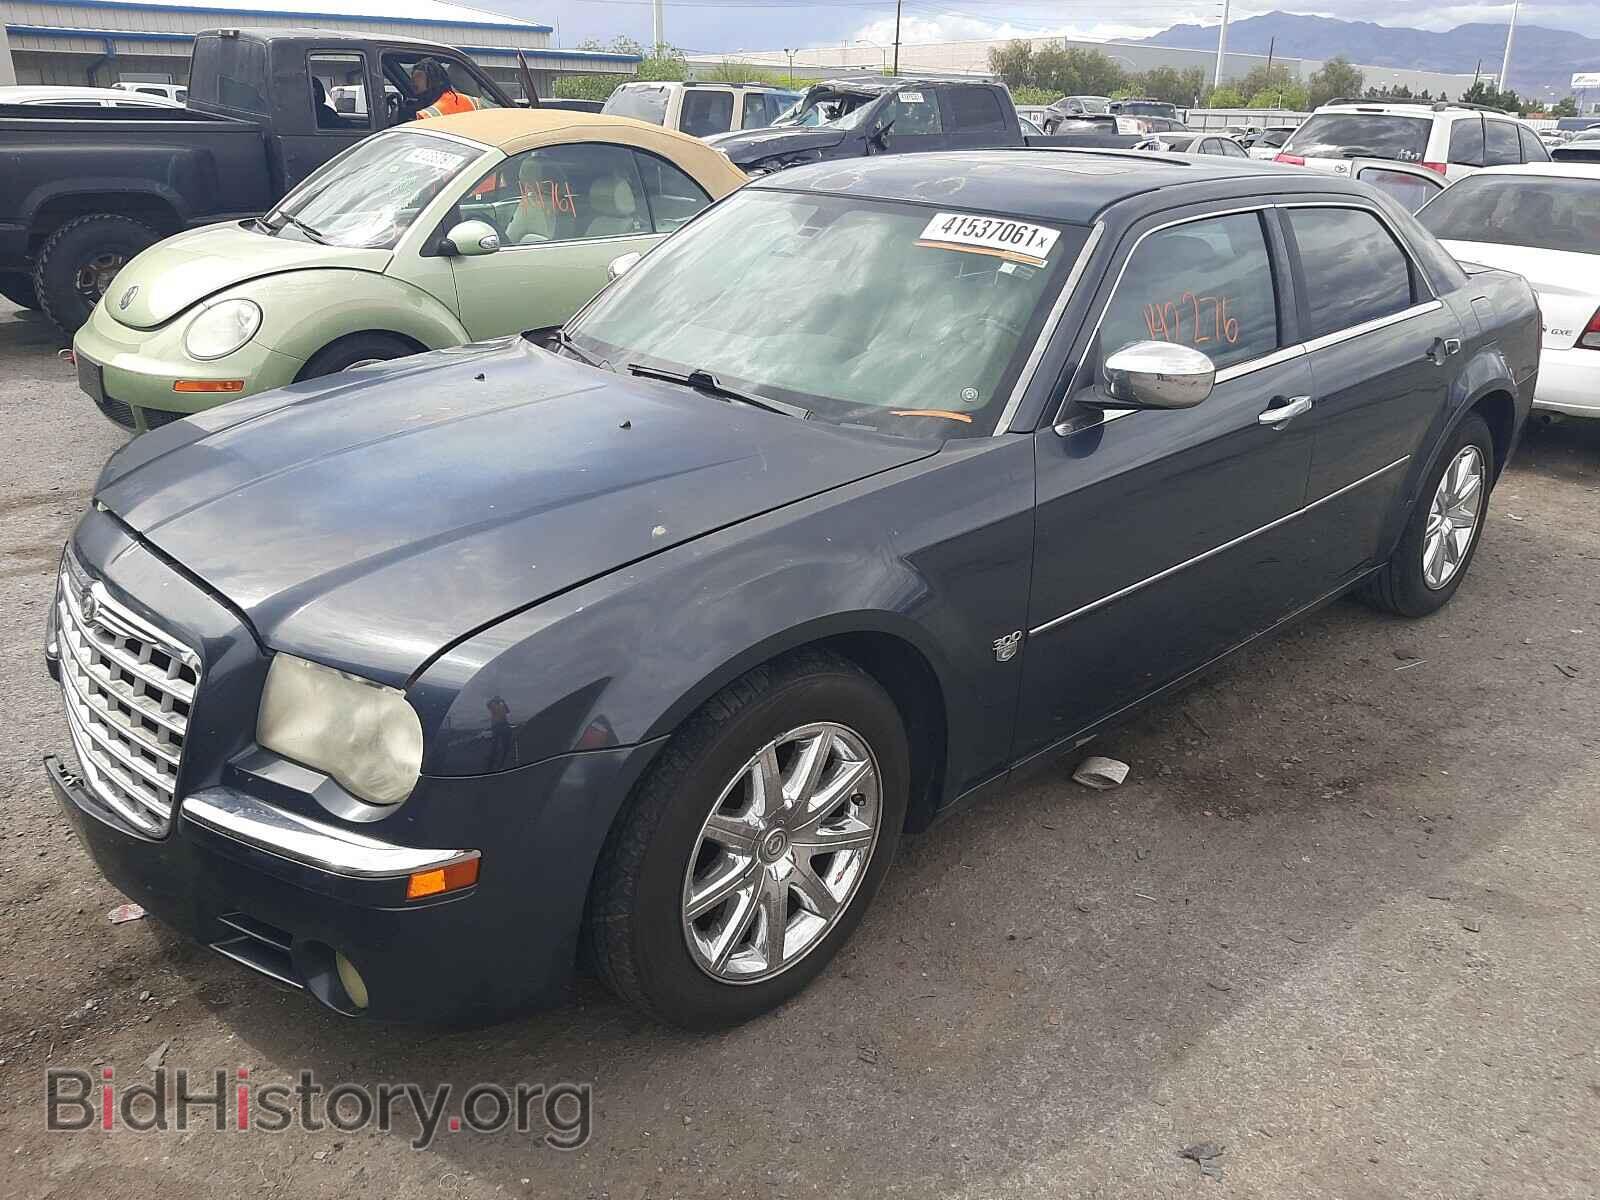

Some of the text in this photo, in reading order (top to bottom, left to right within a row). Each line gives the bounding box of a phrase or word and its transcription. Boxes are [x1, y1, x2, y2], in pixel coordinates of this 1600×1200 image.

[941, 216, 1039, 247] 41537061
[1551, 328, 1572, 336] GXE
[992, 630, 1023, 650] 300
